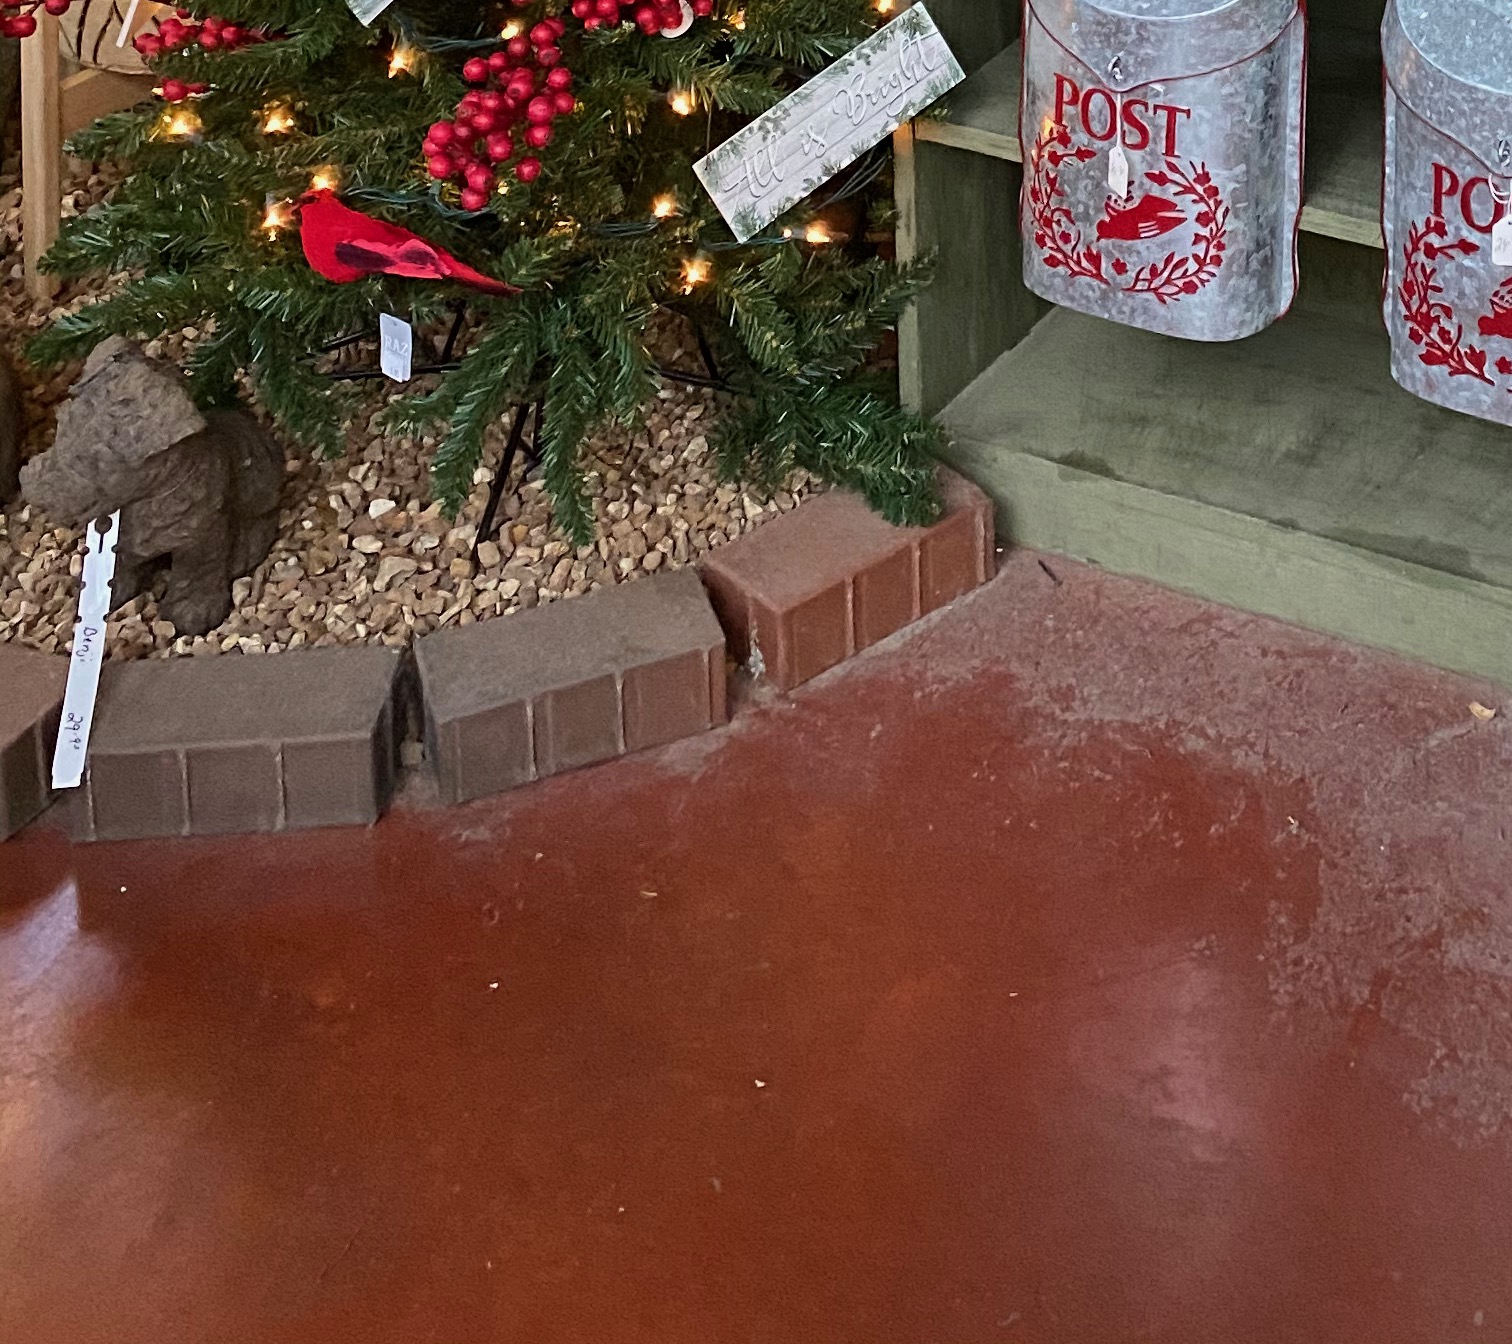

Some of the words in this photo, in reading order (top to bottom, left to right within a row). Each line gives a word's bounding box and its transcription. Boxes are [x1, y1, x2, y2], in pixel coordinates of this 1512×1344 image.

[722, 132, 784, 198] All
[801, 122, 828, 159] is
[832, 31, 940, 126] Bright
[1054, 72, 1191, 158] POST
